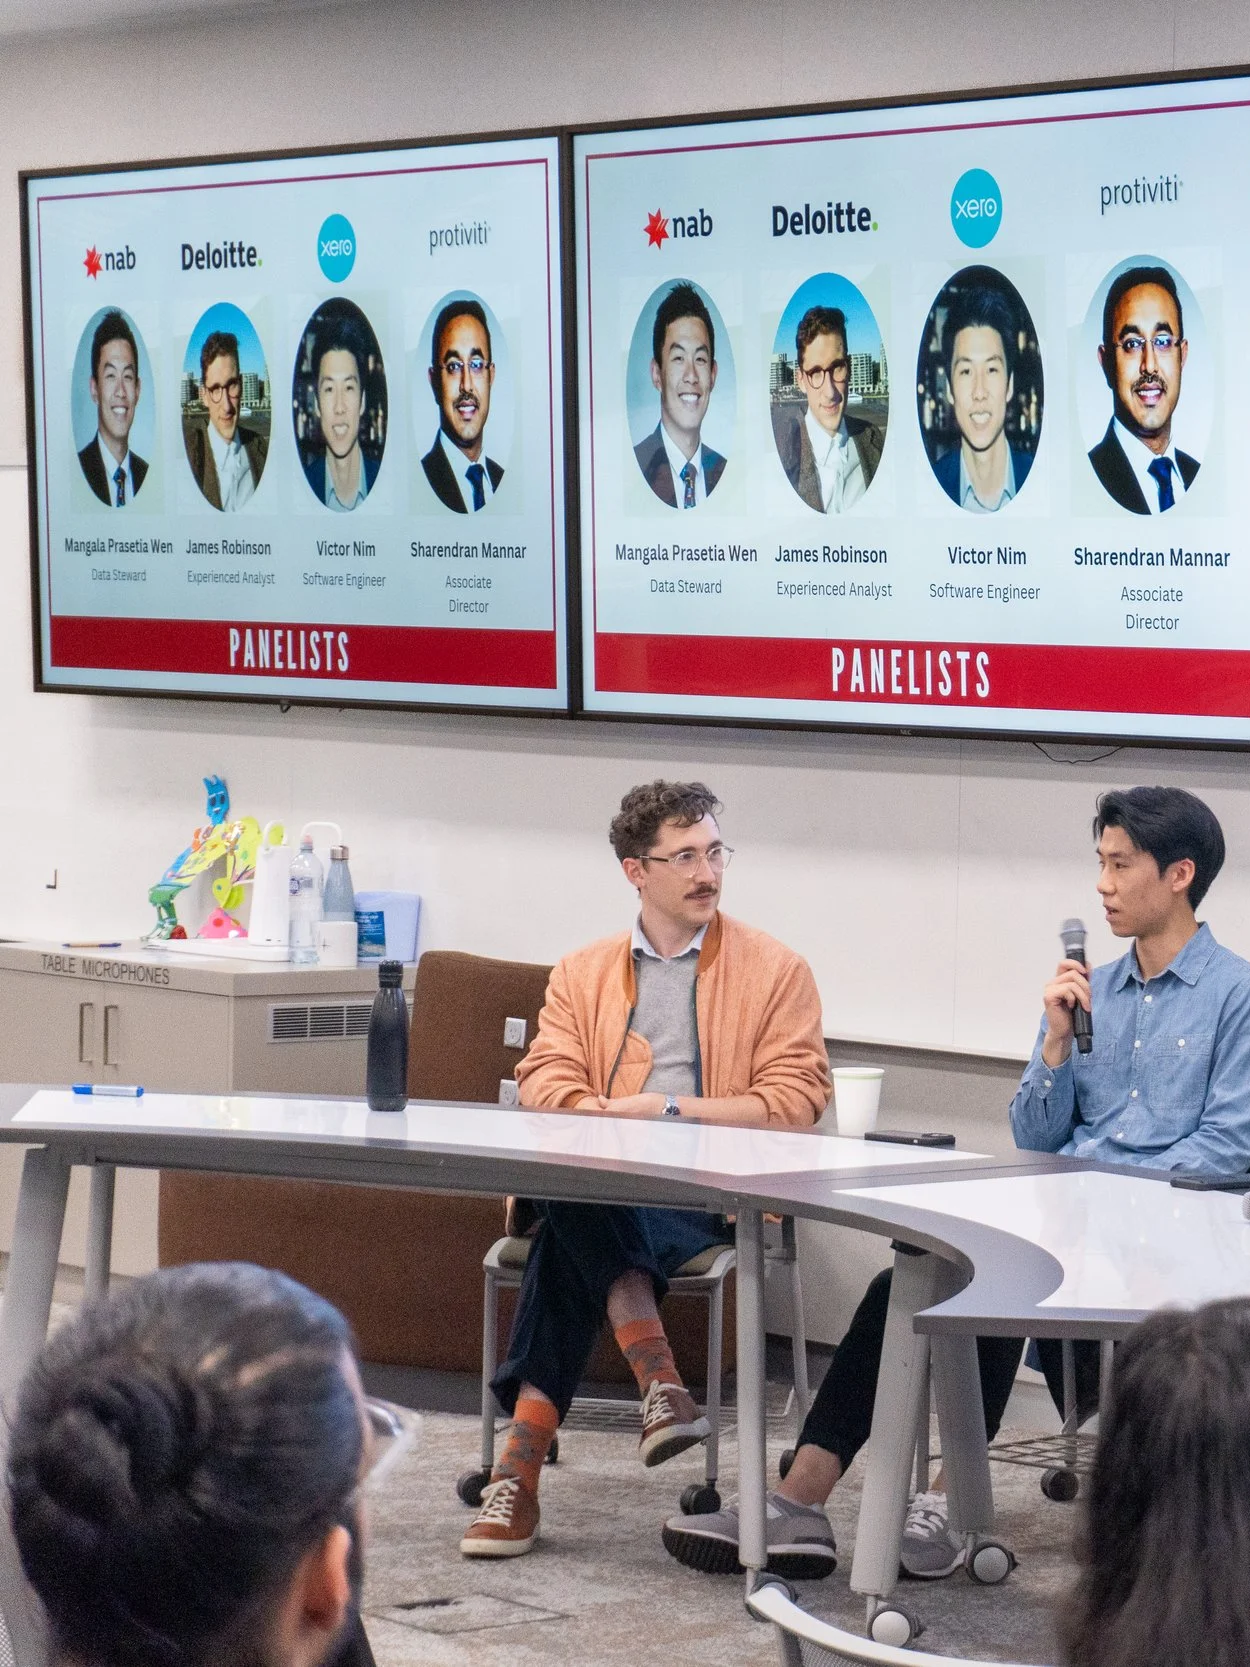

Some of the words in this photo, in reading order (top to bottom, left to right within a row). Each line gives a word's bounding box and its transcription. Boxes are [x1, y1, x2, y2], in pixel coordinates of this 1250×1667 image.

[1101, 175, 1177, 215] protiviti
[955, 197, 997, 218] xero
[673, 209, 712, 238] nab
[430, 222, 487, 255] protiviti
[320, 239, 353, 257] xero
[105, 245, 136, 270] nab
[65, 538, 105, 556] Mangala
[108, 539, 148, 552] Prasetia
[151, 539, 172, 553] Wen
[186, 540, 219, 554] James
[222, 540, 270, 554] Robinson
[317, 541, 350, 556] Victor
[354, 541, 375, 556] Nim
[410, 542, 479, 558] Sharendran
[483, 543, 526, 558] Mannar
[616, 544, 669, 565] Mangala
[673, 545, 725, 561] Prasetia
[729, 545, 757, 561] Wen
[775, 546, 818, 562] James
[823, 546, 887, 563] Robinson
[948, 547, 992, 564] Victor
[998, 547, 1026, 564] Nim
[1075, 548, 1164, 566] Sharendran
[1170, 548, 1230, 566] Mannar
[92, 569, 111, 580] Data
[113, 569, 146, 581] Steward
[187, 571, 240, 585] Experienced
[243, 572, 275, 587] Analyst
[303, 572, 343, 586] Software
[345, 574, 386, 589] Engineer
[446, 576, 491, 588] Associate
[651, 579, 674, 592] Data
[678, 580, 721, 593] Steward
[777, 581, 845, 598] Experienced
[850, 583, 892, 600] Analyst
[929, 583, 984, 599] Software
[986, 585, 1041, 604] Engineer
[1121, 587, 1182, 601] Associate
[450, 600, 489, 612] Director
[1125, 614, 1179, 630] Director
[229, 627, 349, 671] PANELISTS
[832, 647, 991, 698] PANELISTS
[42, 954, 76, 973] TABLE
[82, 960, 170, 984] MICROPHONES
